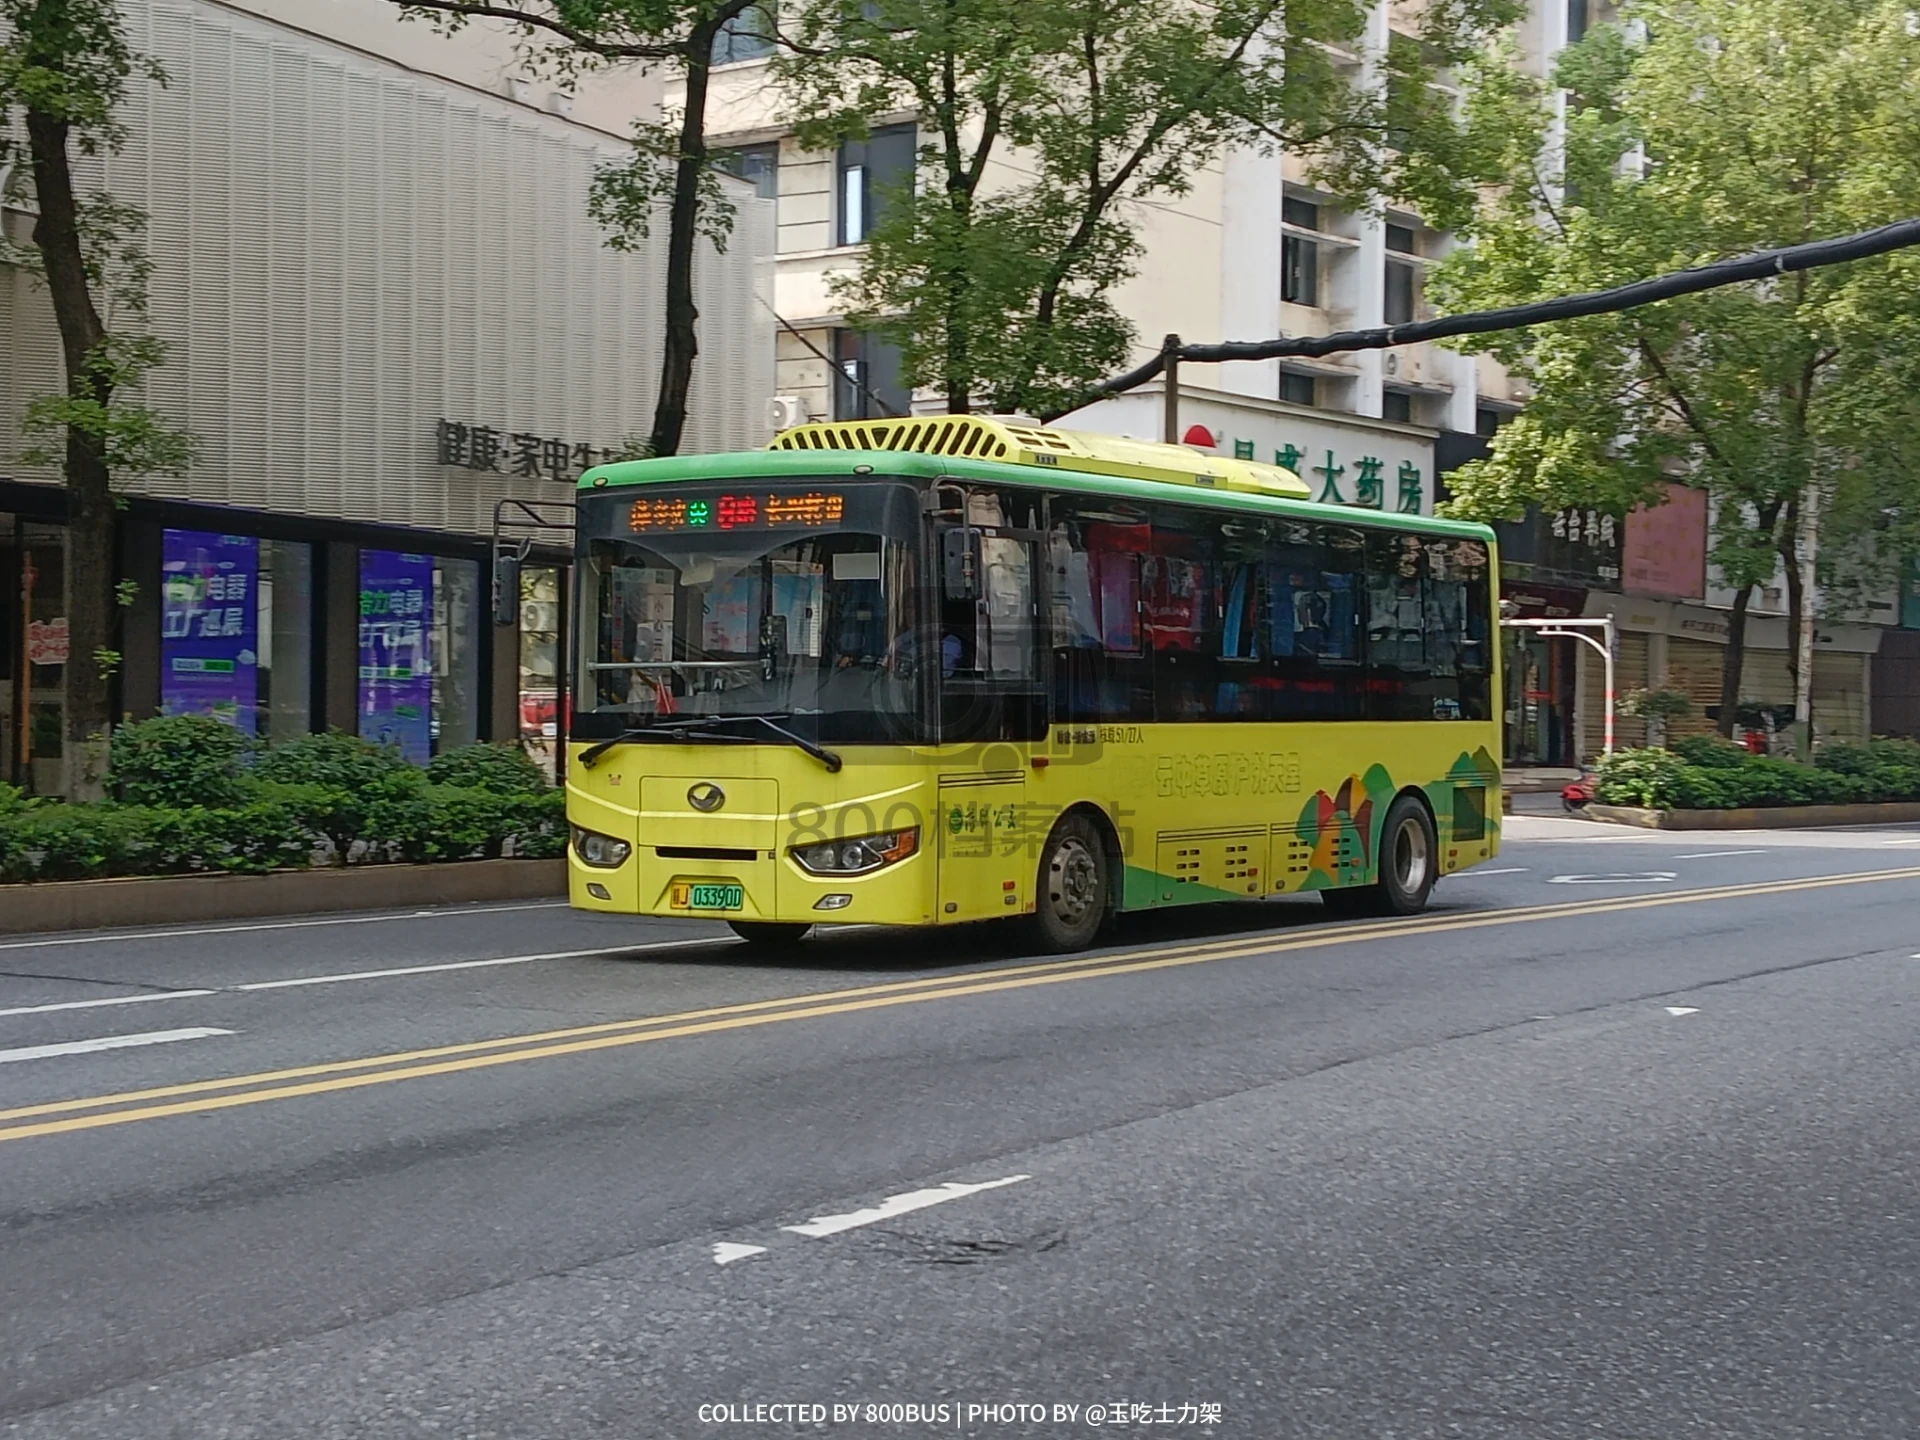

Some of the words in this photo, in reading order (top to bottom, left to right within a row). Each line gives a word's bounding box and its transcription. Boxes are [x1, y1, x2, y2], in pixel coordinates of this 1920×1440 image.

[436, 417, 617, 483] 健康·家电生
